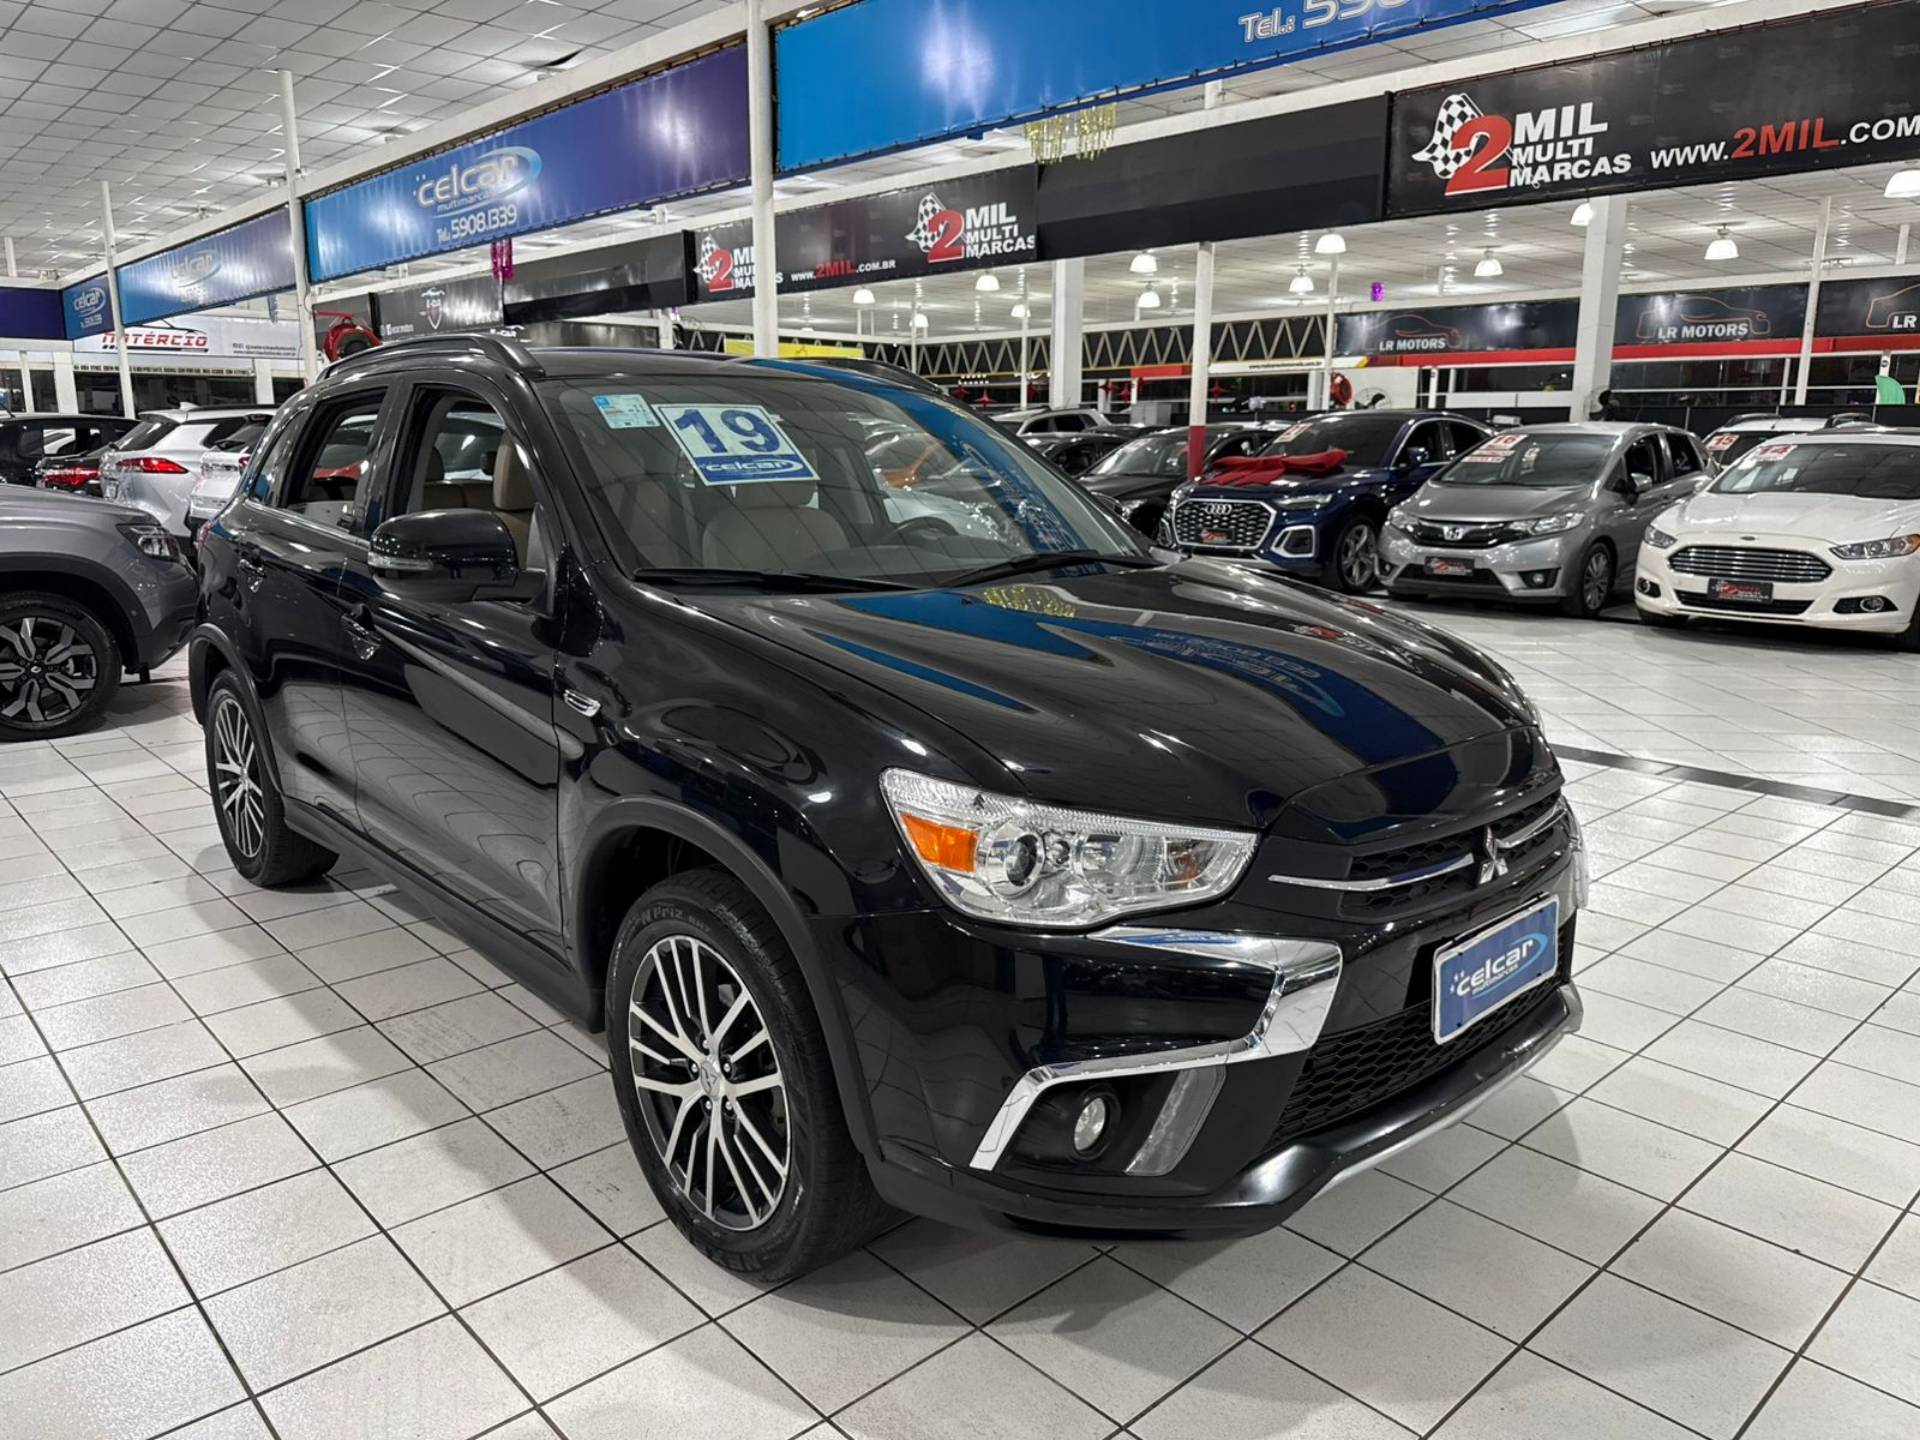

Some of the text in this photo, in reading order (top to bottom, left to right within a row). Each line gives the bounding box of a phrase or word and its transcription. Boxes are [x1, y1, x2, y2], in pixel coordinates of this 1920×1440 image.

[1238, 7, 1296, 43] Tel.:
[1444, 102, 1608, 196] 2 MIL
[1511, 137, 1594, 166] MULTI
[418, 155, 519, 209] celcar
[1509, 154, 1632, 188] MARCAS
[928, 202, 1017, 263] 2 MIL
[966, 223, 1019, 245] MULTI
[966, 234, 1036, 259] MARCAS
[708, 246, 756, 293] 2 MI
[1657, 322, 1749, 339] LR MOTORS
[1891, 314, 1919, 329] LR
[1379, 337, 1446, 352] LR MOTORS
[674, 409, 781, 453] 19
[1456, 939, 1533, 996] celcar
